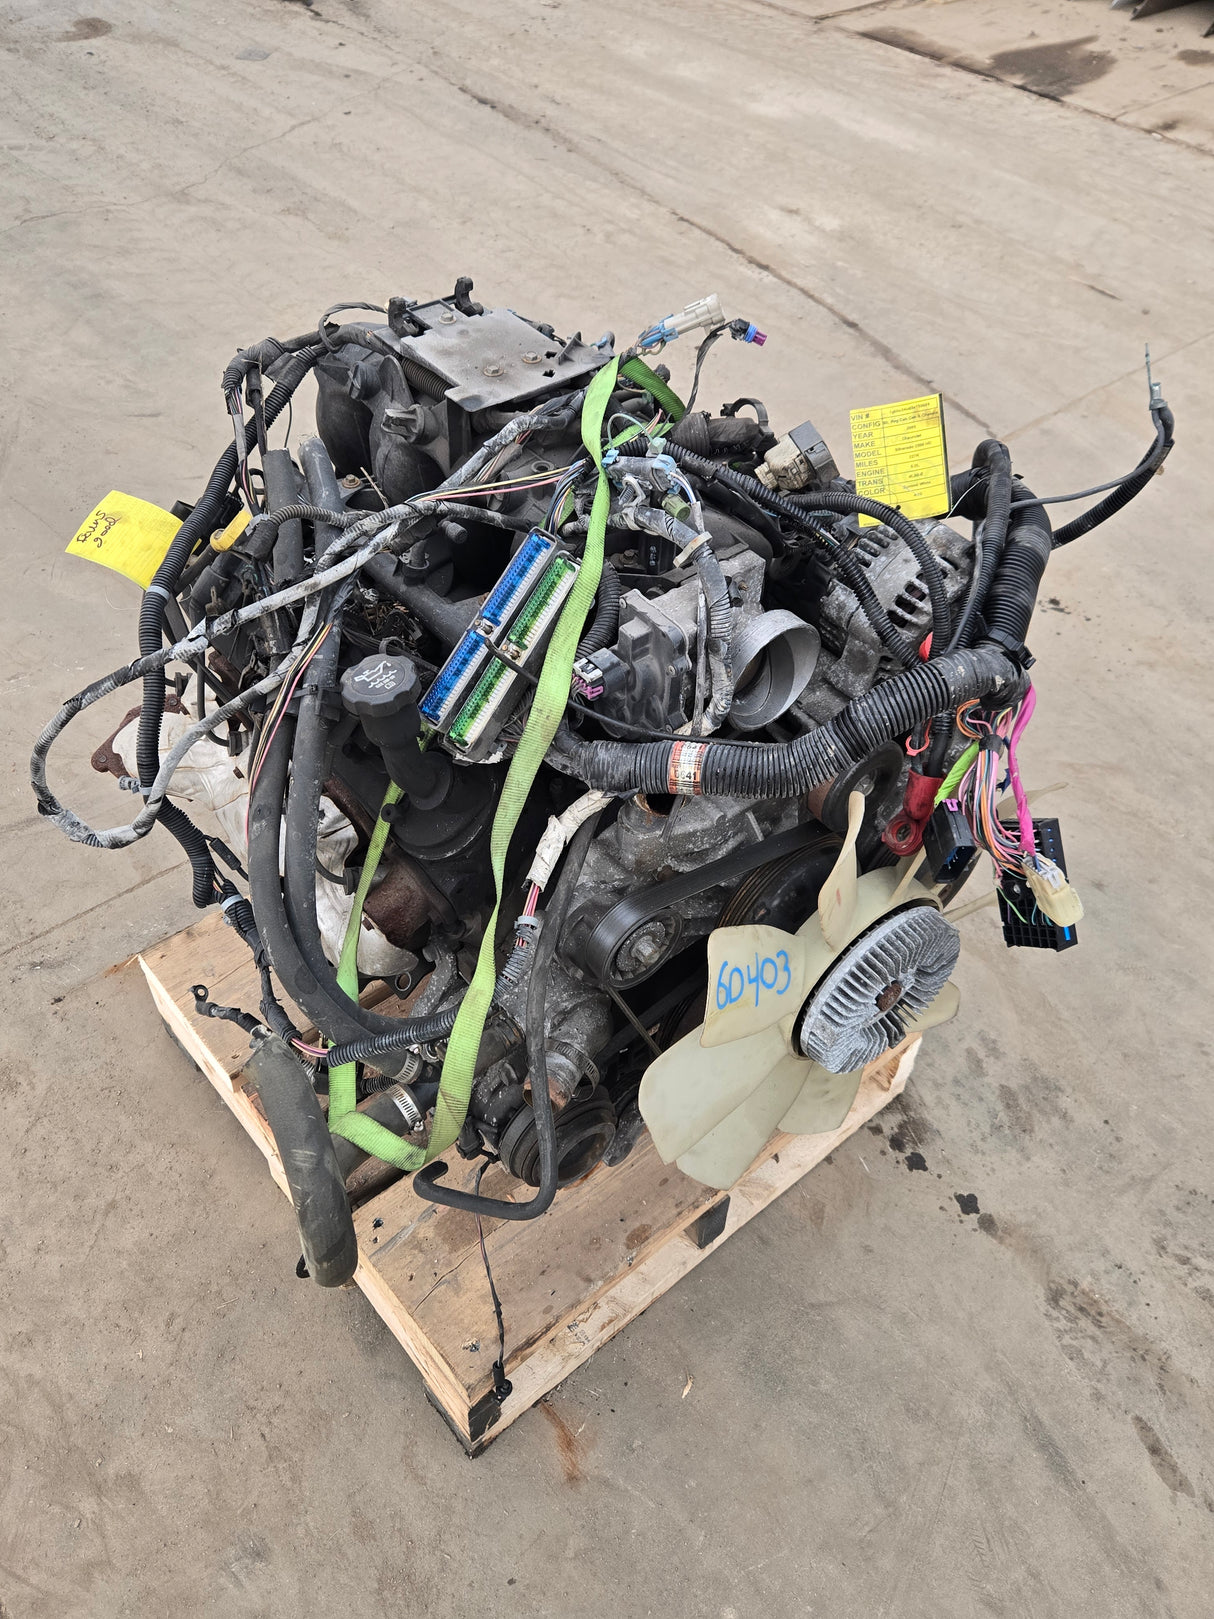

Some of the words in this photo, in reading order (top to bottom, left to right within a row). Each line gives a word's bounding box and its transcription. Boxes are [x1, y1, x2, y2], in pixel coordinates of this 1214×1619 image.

[851, 414, 863, 422] VIN
[852, 420, 881, 431] CONFIG
[853, 432, 874, 440] YEAR
[854, 441, 876, 449] MAKE
[855, 448, 882, 459] MODEL
[856, 460, 879, 468] MILES
[857, 468, 885, 477] ENGINE
[858, 478, 884, 487] TRANS
[859, 487, 886, 497] COLOR
[716, 949, 791, 1010] 60403
